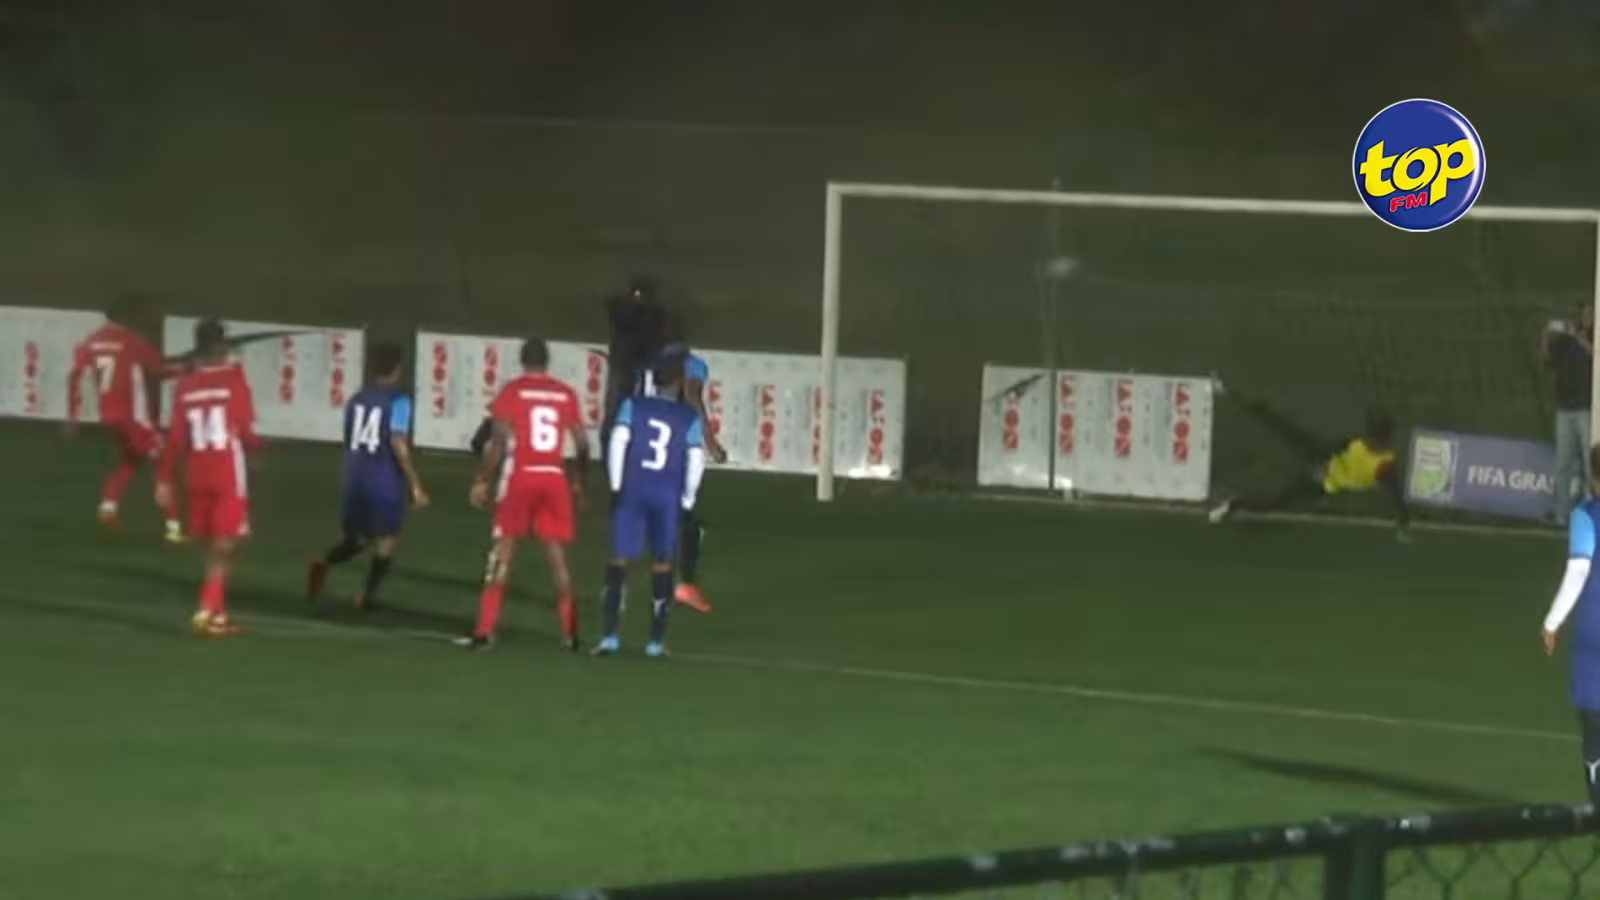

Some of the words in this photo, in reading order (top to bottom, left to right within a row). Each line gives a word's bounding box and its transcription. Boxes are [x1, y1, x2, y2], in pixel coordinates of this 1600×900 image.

[97, 355, 115, 392] 7
[187, 405, 227, 451] 14
[351, 404, 381, 452] 14
[530, 405, 559, 451] 6
[641, 418, 671, 470] 3
[1467, 465, 1505, 486] FIFA
